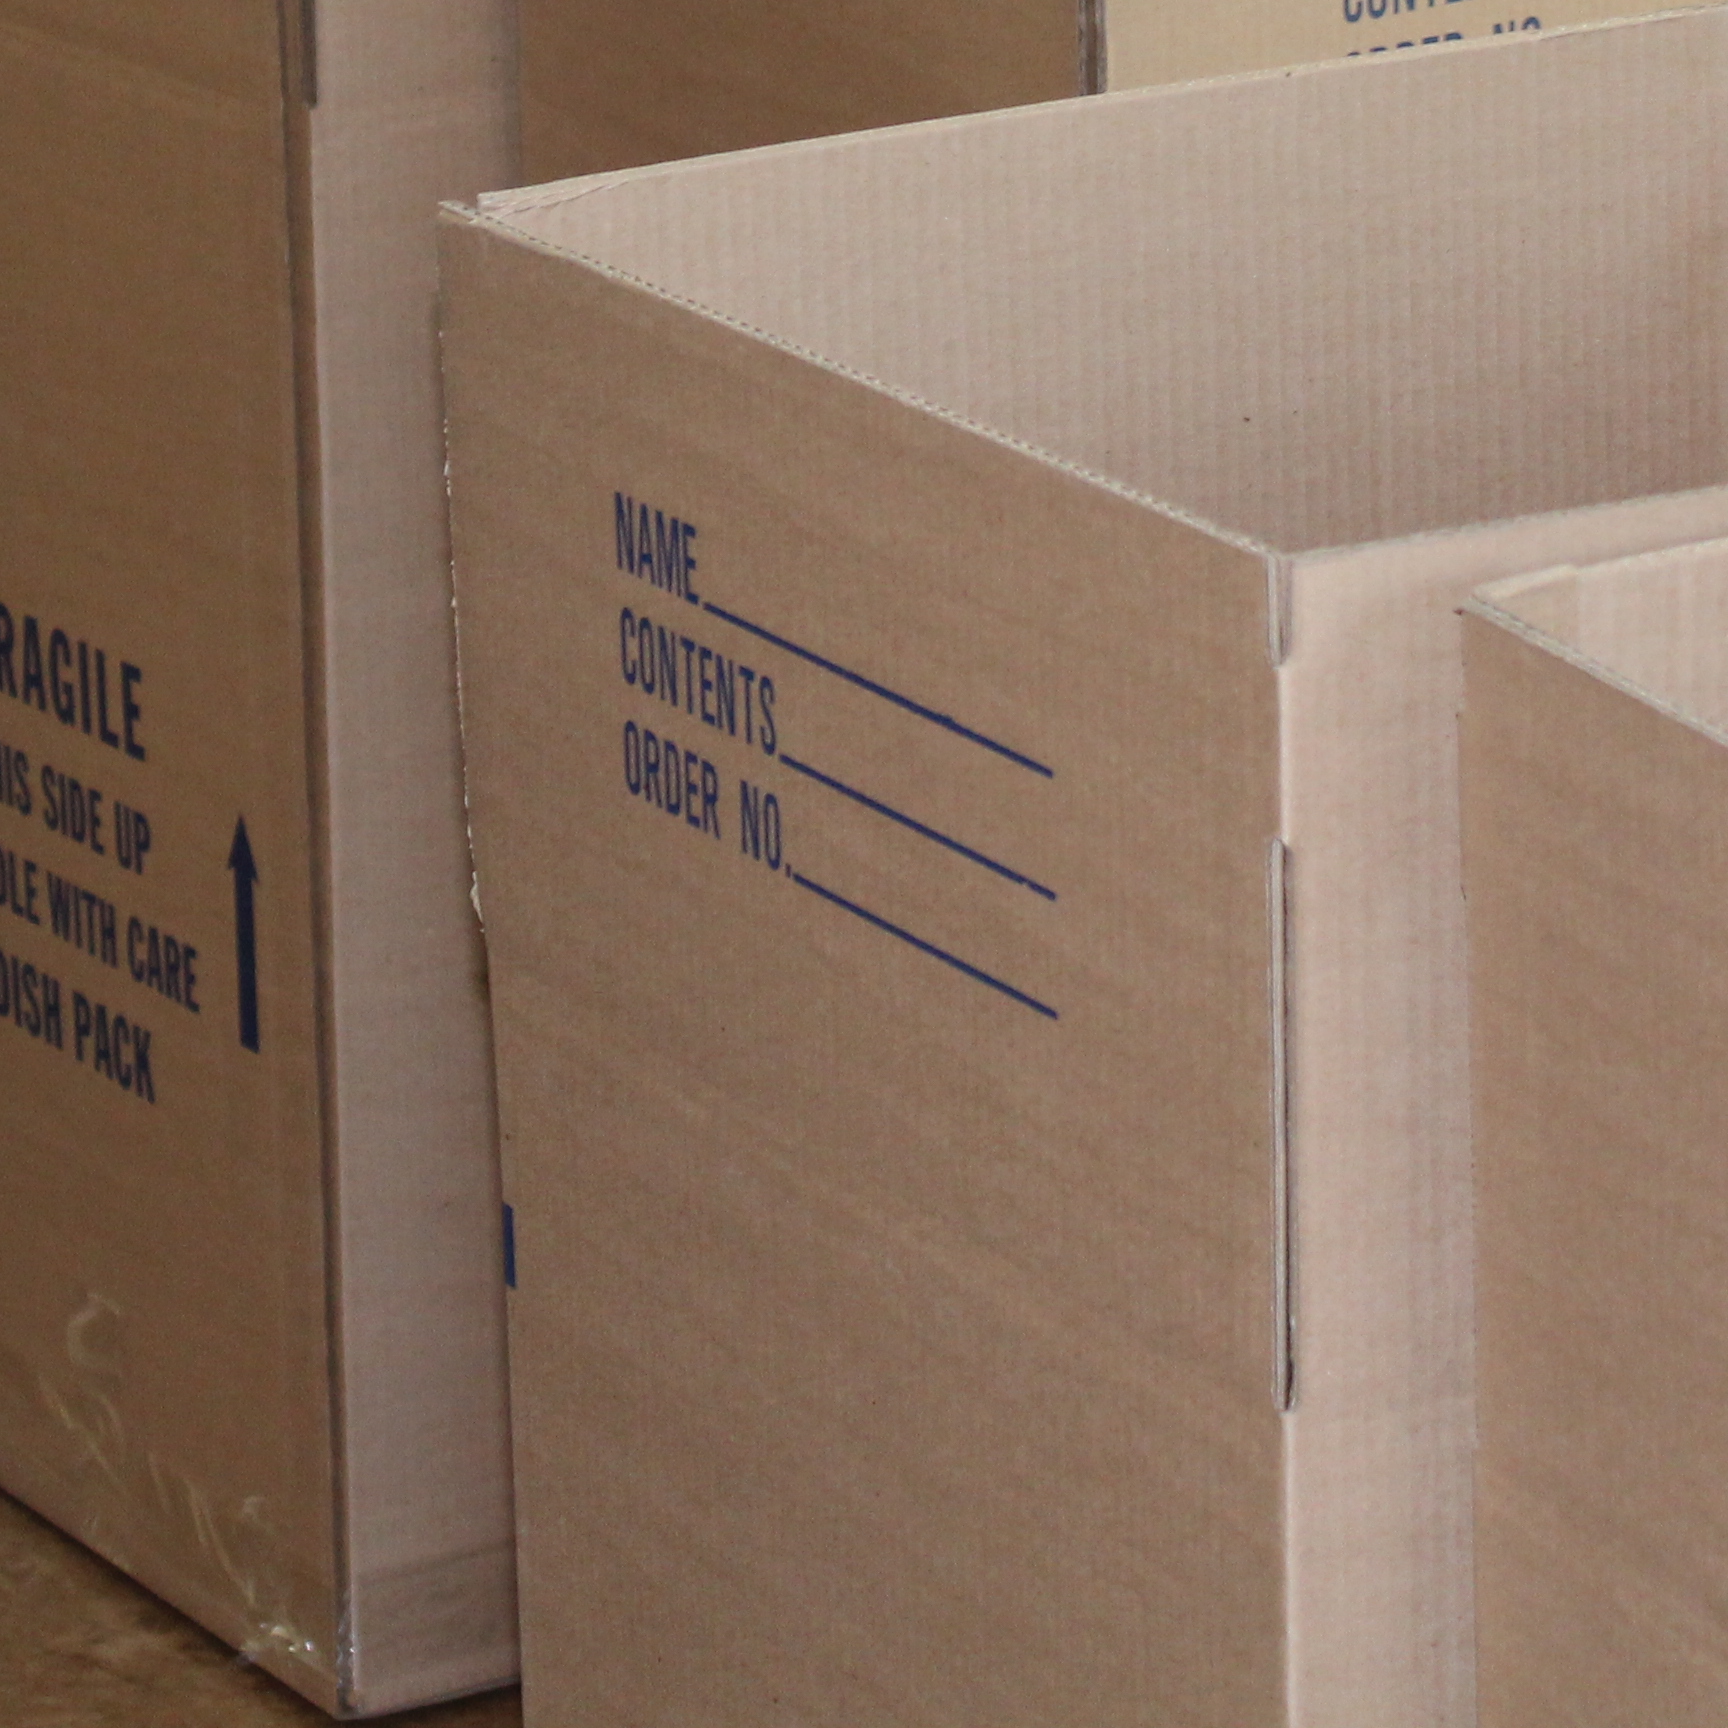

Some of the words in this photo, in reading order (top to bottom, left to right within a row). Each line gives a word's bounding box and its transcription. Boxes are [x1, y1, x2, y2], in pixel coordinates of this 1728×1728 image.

[615, 491, 699, 606] NAME
[620, 606, 777, 757] CONTENTS
[41, 764, 104, 856] SIDE
[114, 800, 150, 874] UP
[623, 720, 721, 840] ORDER
[740, 779, 792, 878] NO.
[47, 872, 116, 970] WITH
[127, 916, 200, 1013] CARE
[72, 990, 155, 1104] PACK
